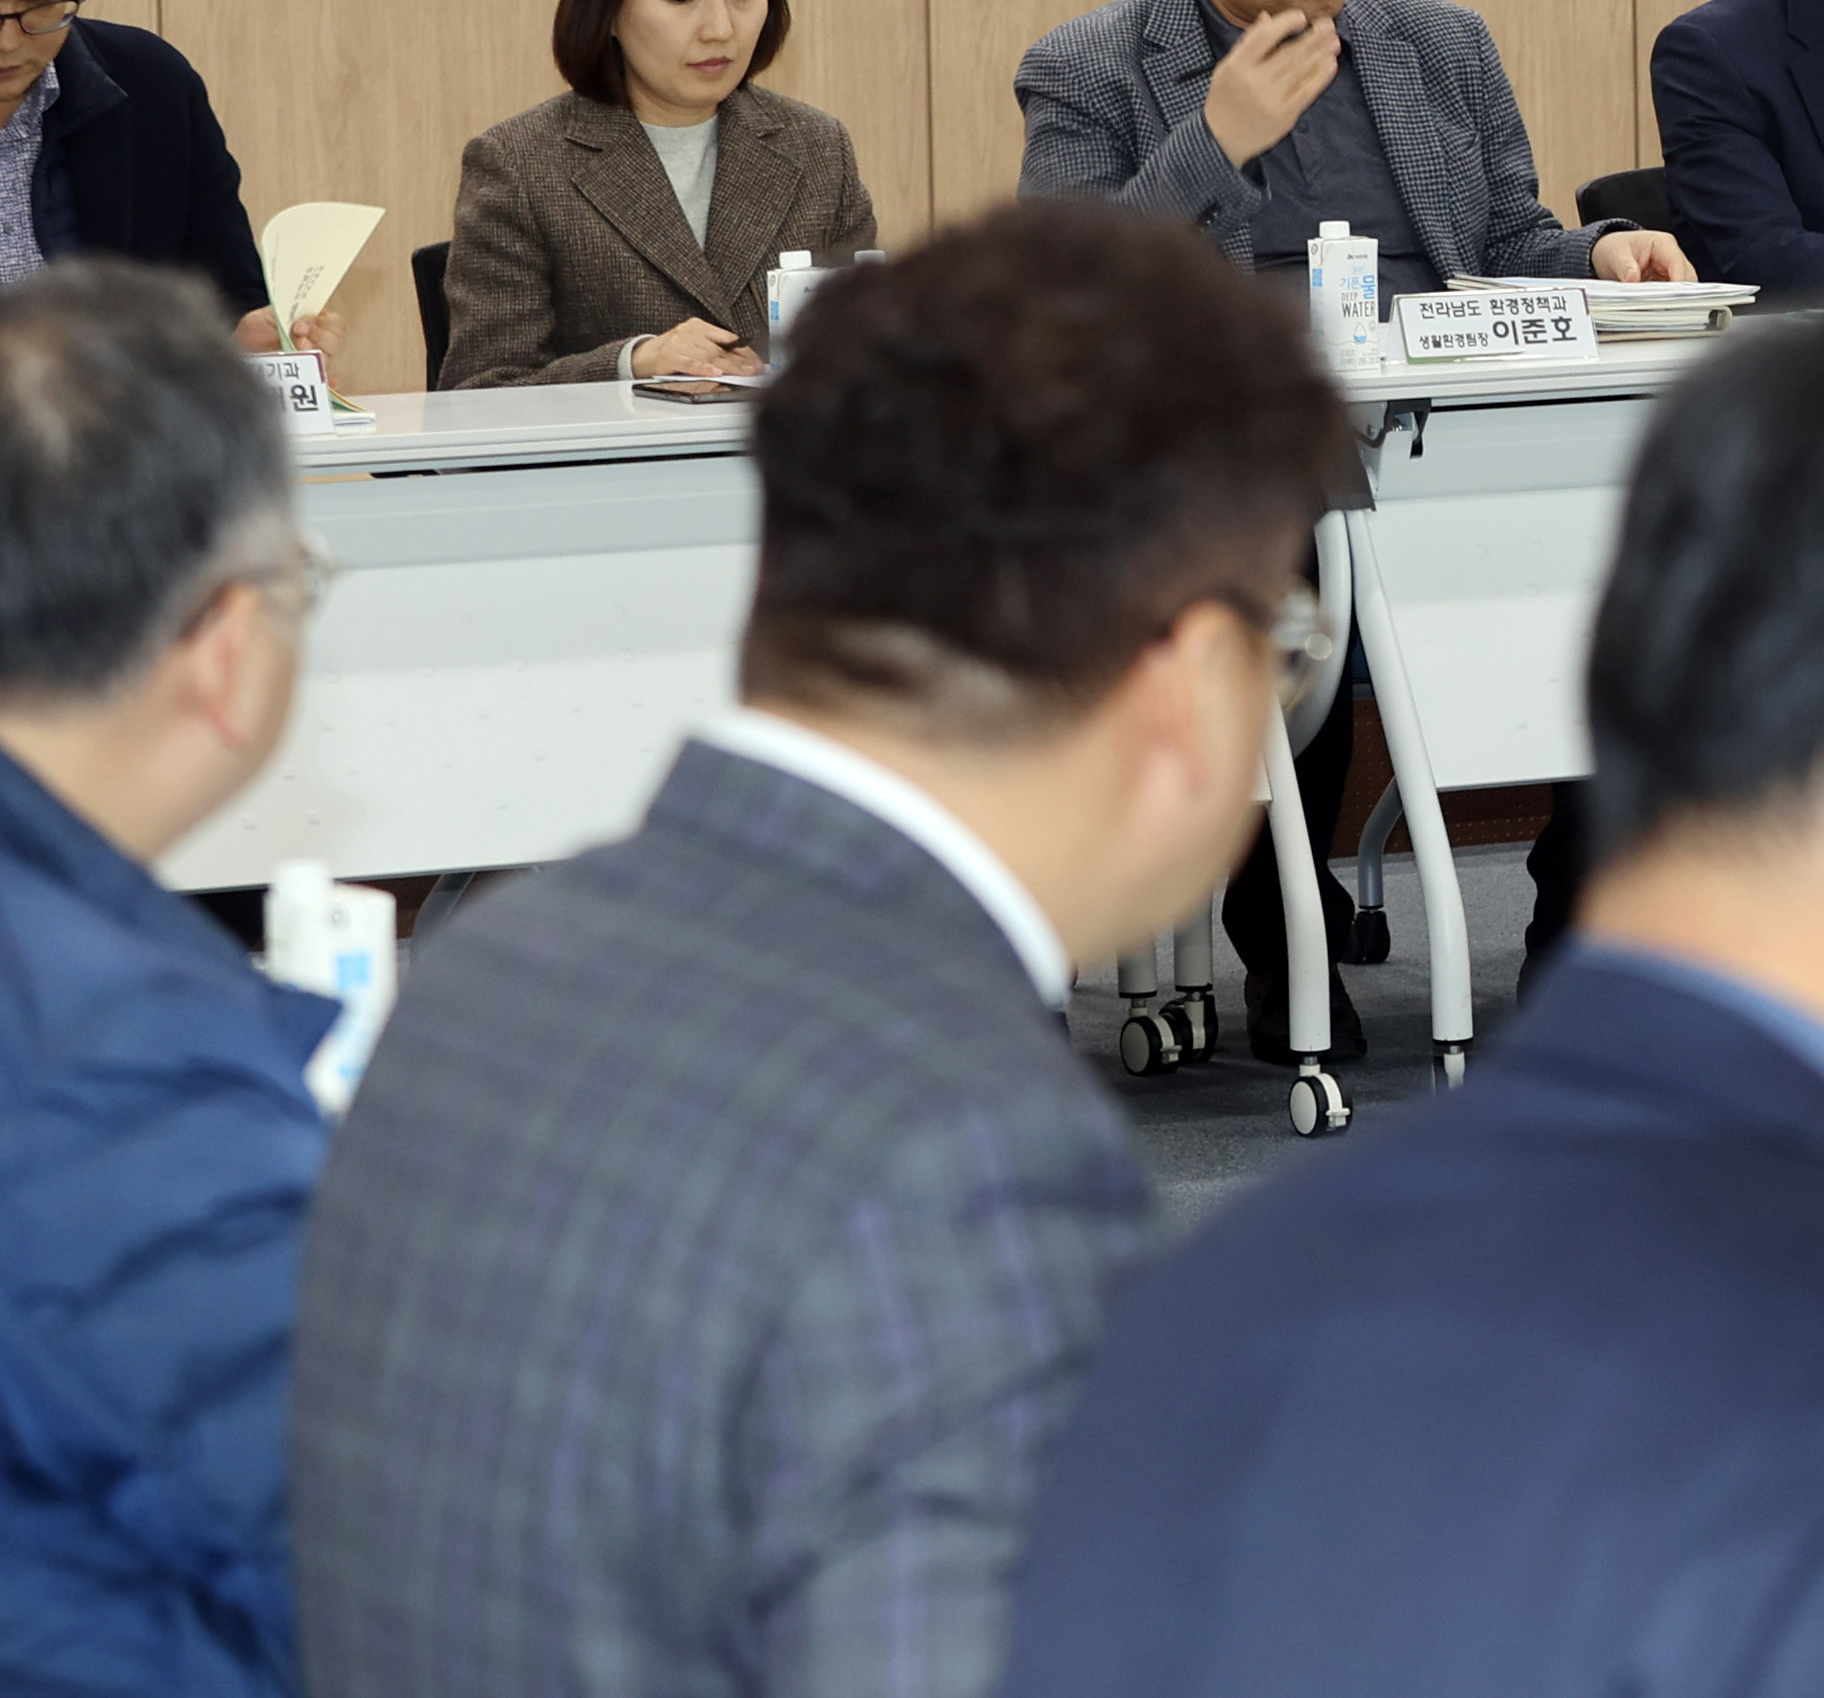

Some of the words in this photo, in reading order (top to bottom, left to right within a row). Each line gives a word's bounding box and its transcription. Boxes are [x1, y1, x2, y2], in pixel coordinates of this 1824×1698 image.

[1341, 301, 1376, 319] WATER
[1419, 300, 1482, 319] 전라남도
[1489, 295, 1567, 316] 환경정책과
[1419, 332, 1489, 350] 생활환경팀장
[1492, 316, 1578, 345] 이준호
